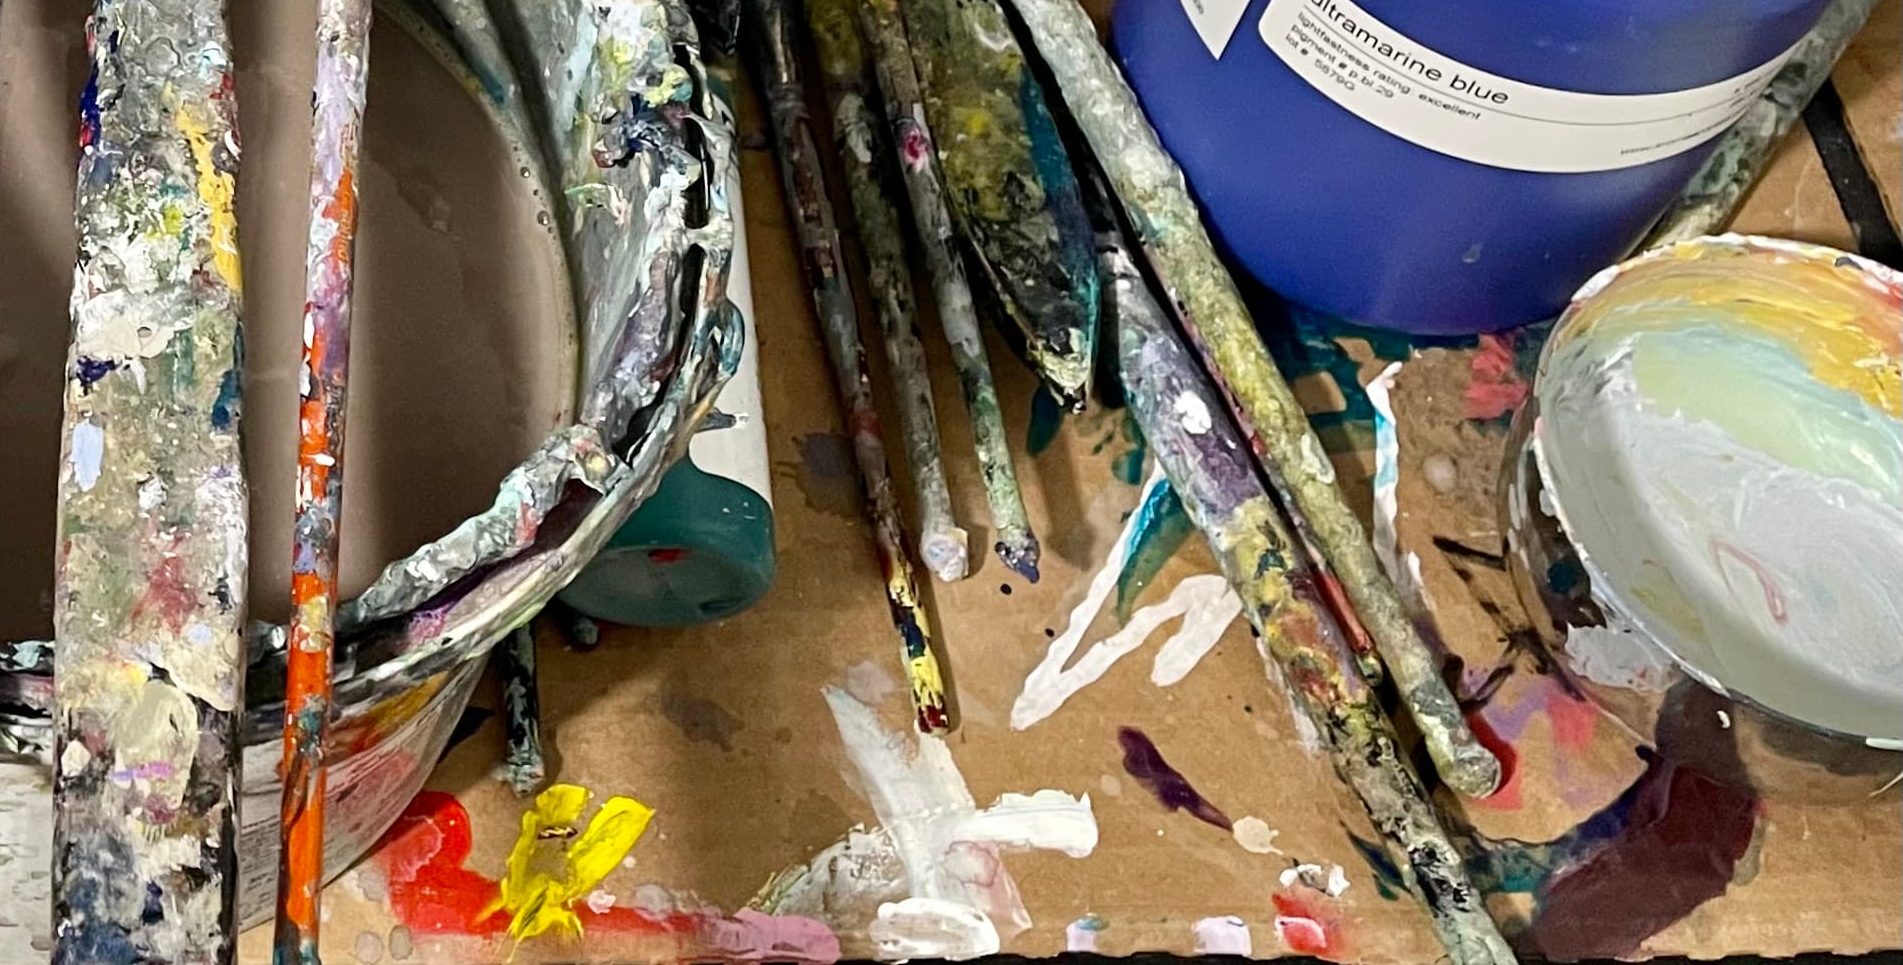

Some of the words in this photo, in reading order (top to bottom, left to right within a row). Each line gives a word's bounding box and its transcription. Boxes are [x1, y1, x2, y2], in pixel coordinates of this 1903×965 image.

[1284, 32, 1300, 51] lot
[1289, 23, 1338, 66] pigment
[1297, 10, 1371, 72] lightfastness
[1417, 93, 1483, 122] excellent
[1449, 73, 1510, 105] blue
